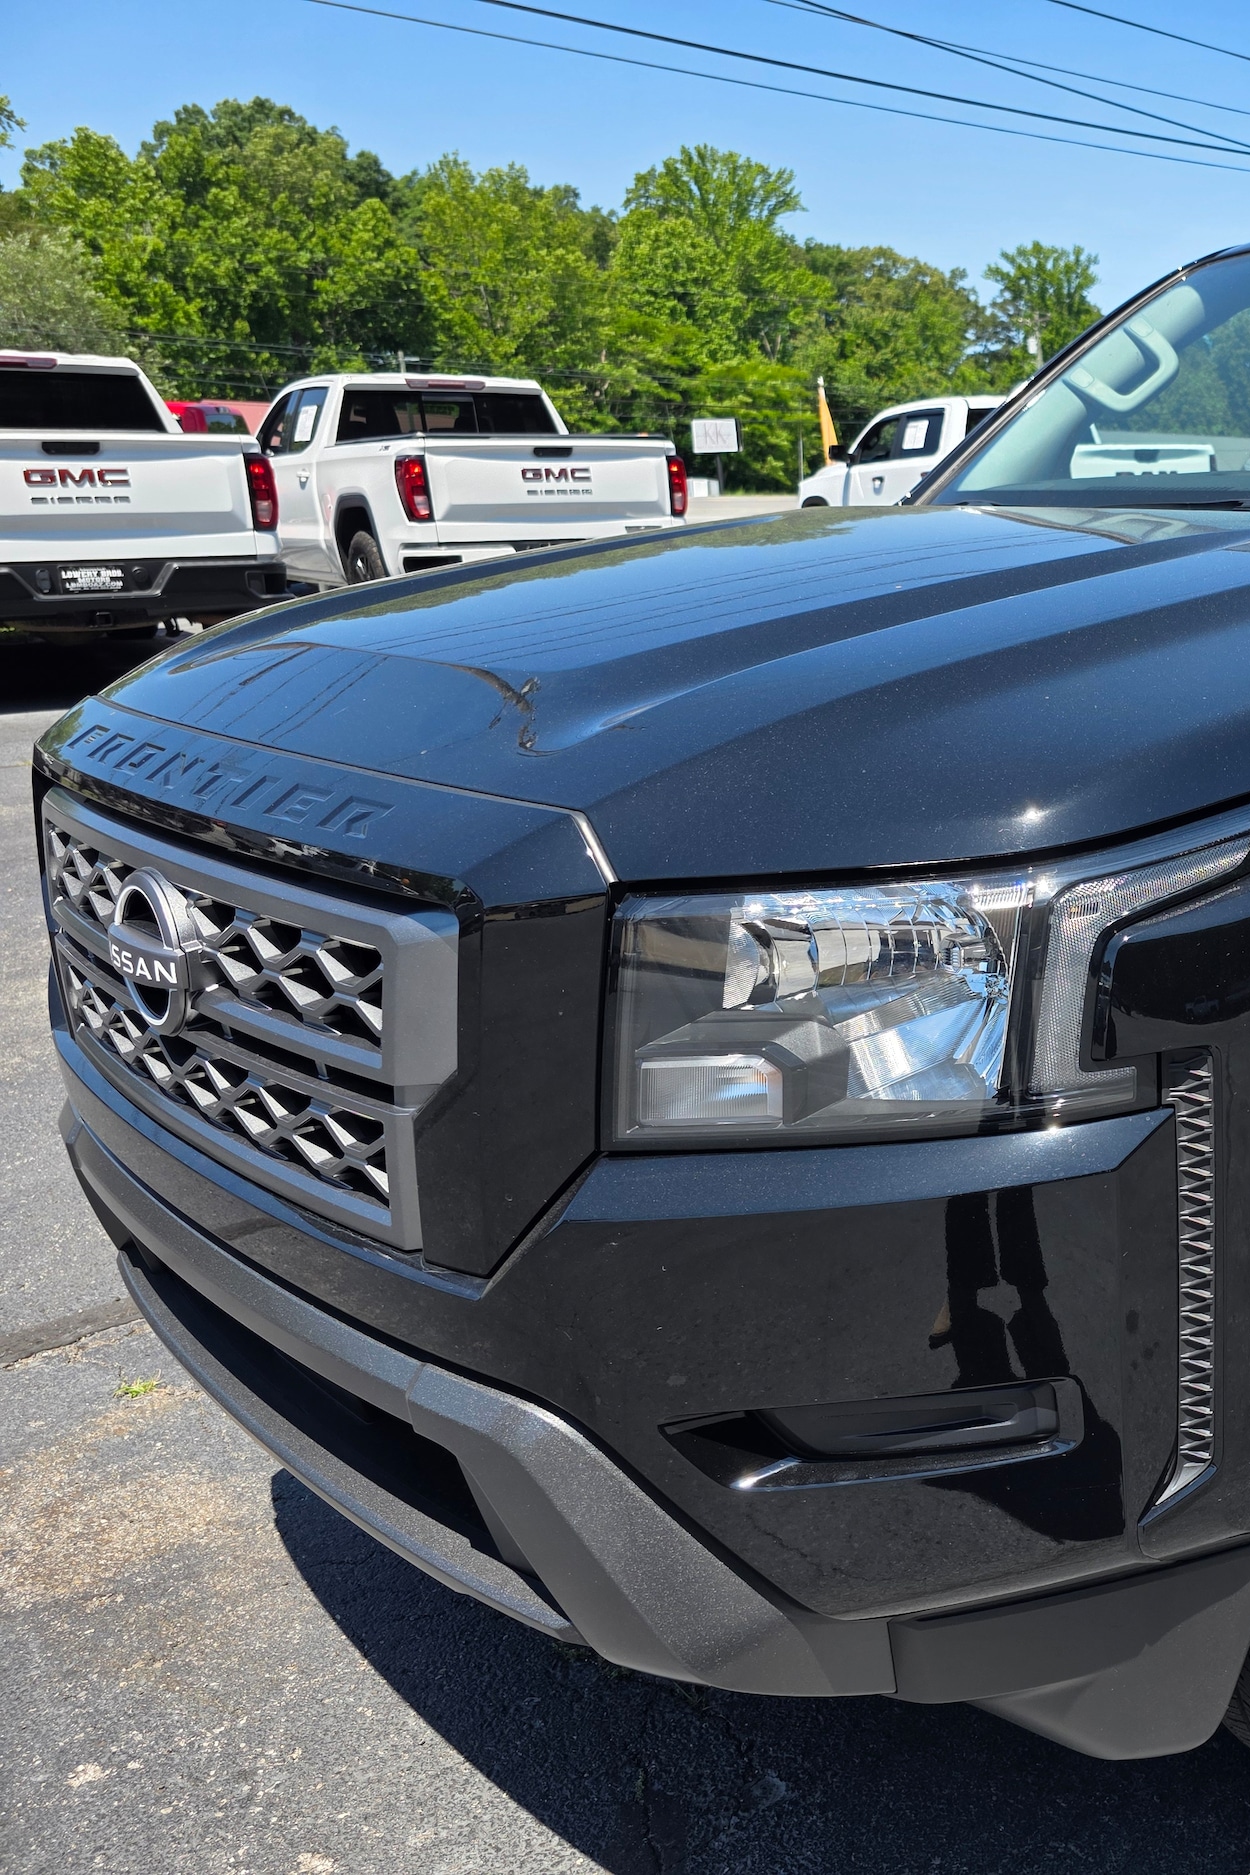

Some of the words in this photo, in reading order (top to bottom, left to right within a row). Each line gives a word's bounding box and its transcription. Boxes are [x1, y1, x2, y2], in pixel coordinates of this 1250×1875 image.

[23, 468, 131, 488] GMC
[521, 467, 592, 483] GMC
[67, 724, 396, 839] FRONTIER
[111, 943, 178, 984] SSAN
